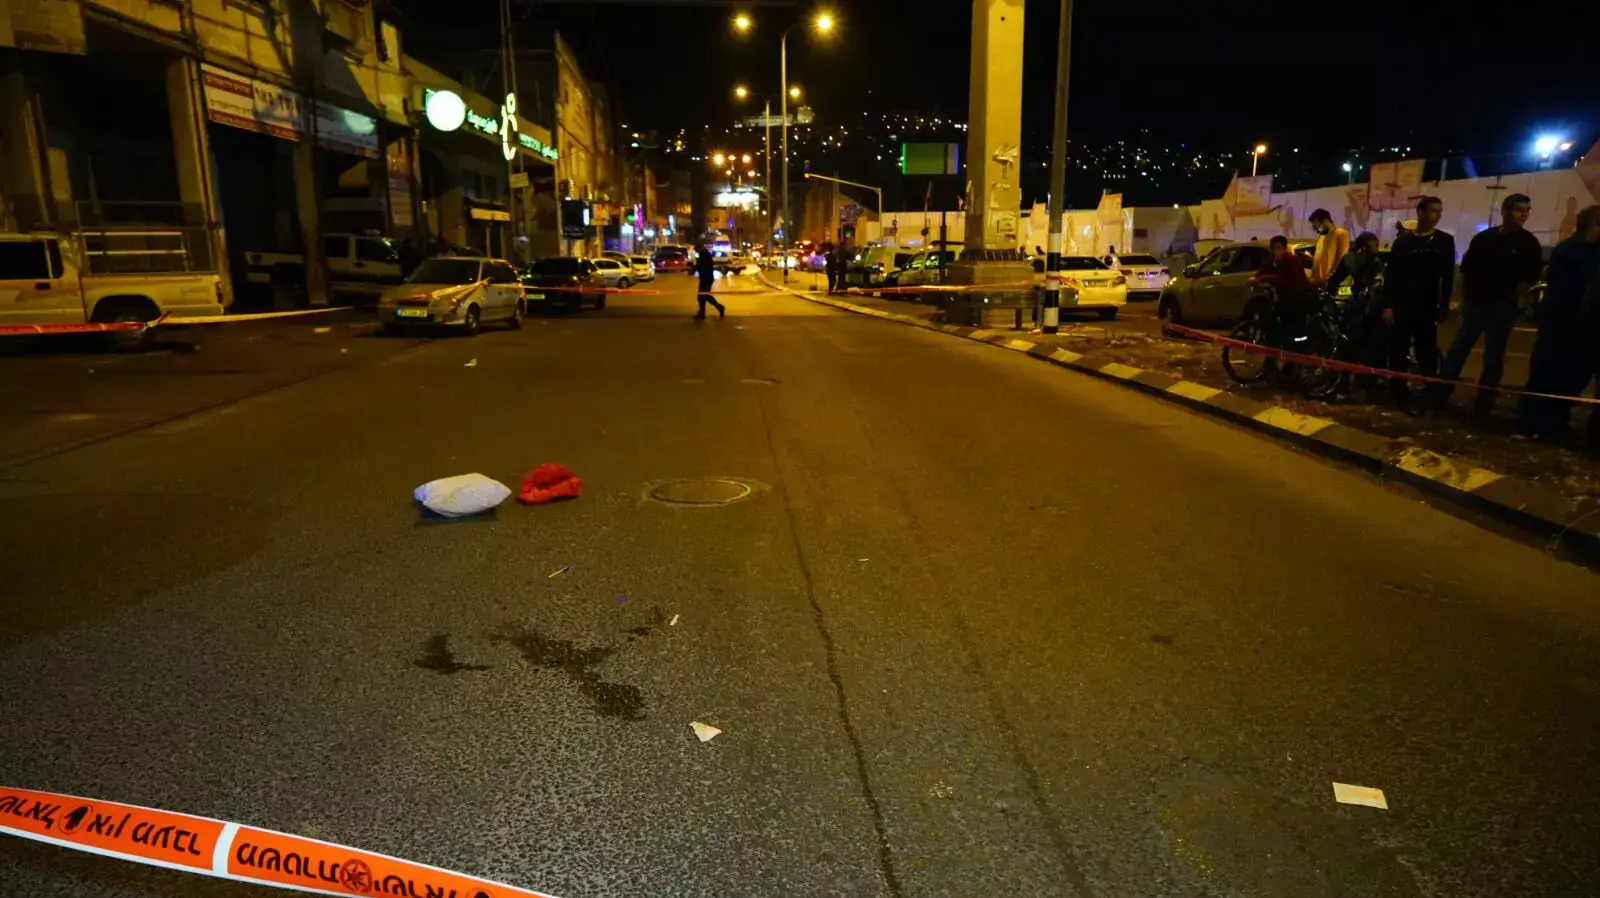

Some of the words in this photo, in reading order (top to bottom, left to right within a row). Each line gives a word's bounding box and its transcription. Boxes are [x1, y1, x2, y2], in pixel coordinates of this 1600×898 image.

[0, 795, 61, 830] שראל
[87, 812, 132, 838] אין
[132, 821, 201, 856] מעבר
[236, 842, 340, 882] משטרת
